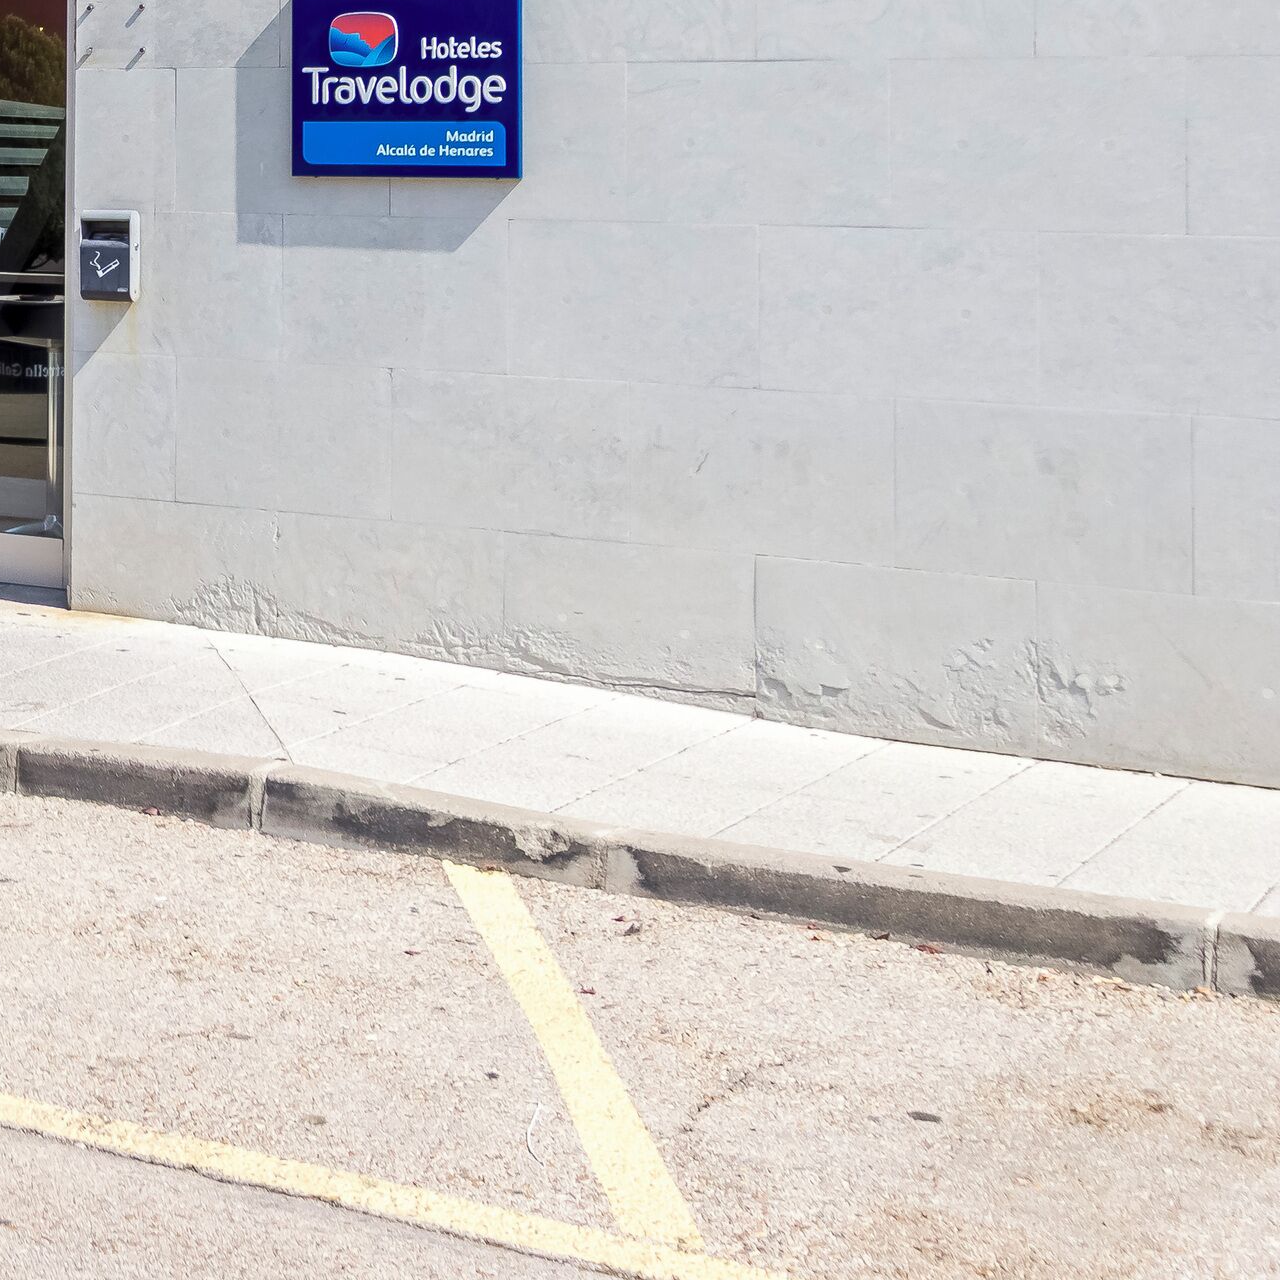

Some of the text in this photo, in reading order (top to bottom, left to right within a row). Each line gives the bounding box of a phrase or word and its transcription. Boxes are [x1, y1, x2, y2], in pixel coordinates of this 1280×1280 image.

[420, 36, 503, 60] Hoteles
[301, 65, 507, 113] Travelodge
[446, 130, 494, 142] Madrid
[376, 144, 494, 158] Alcalá de Henares
